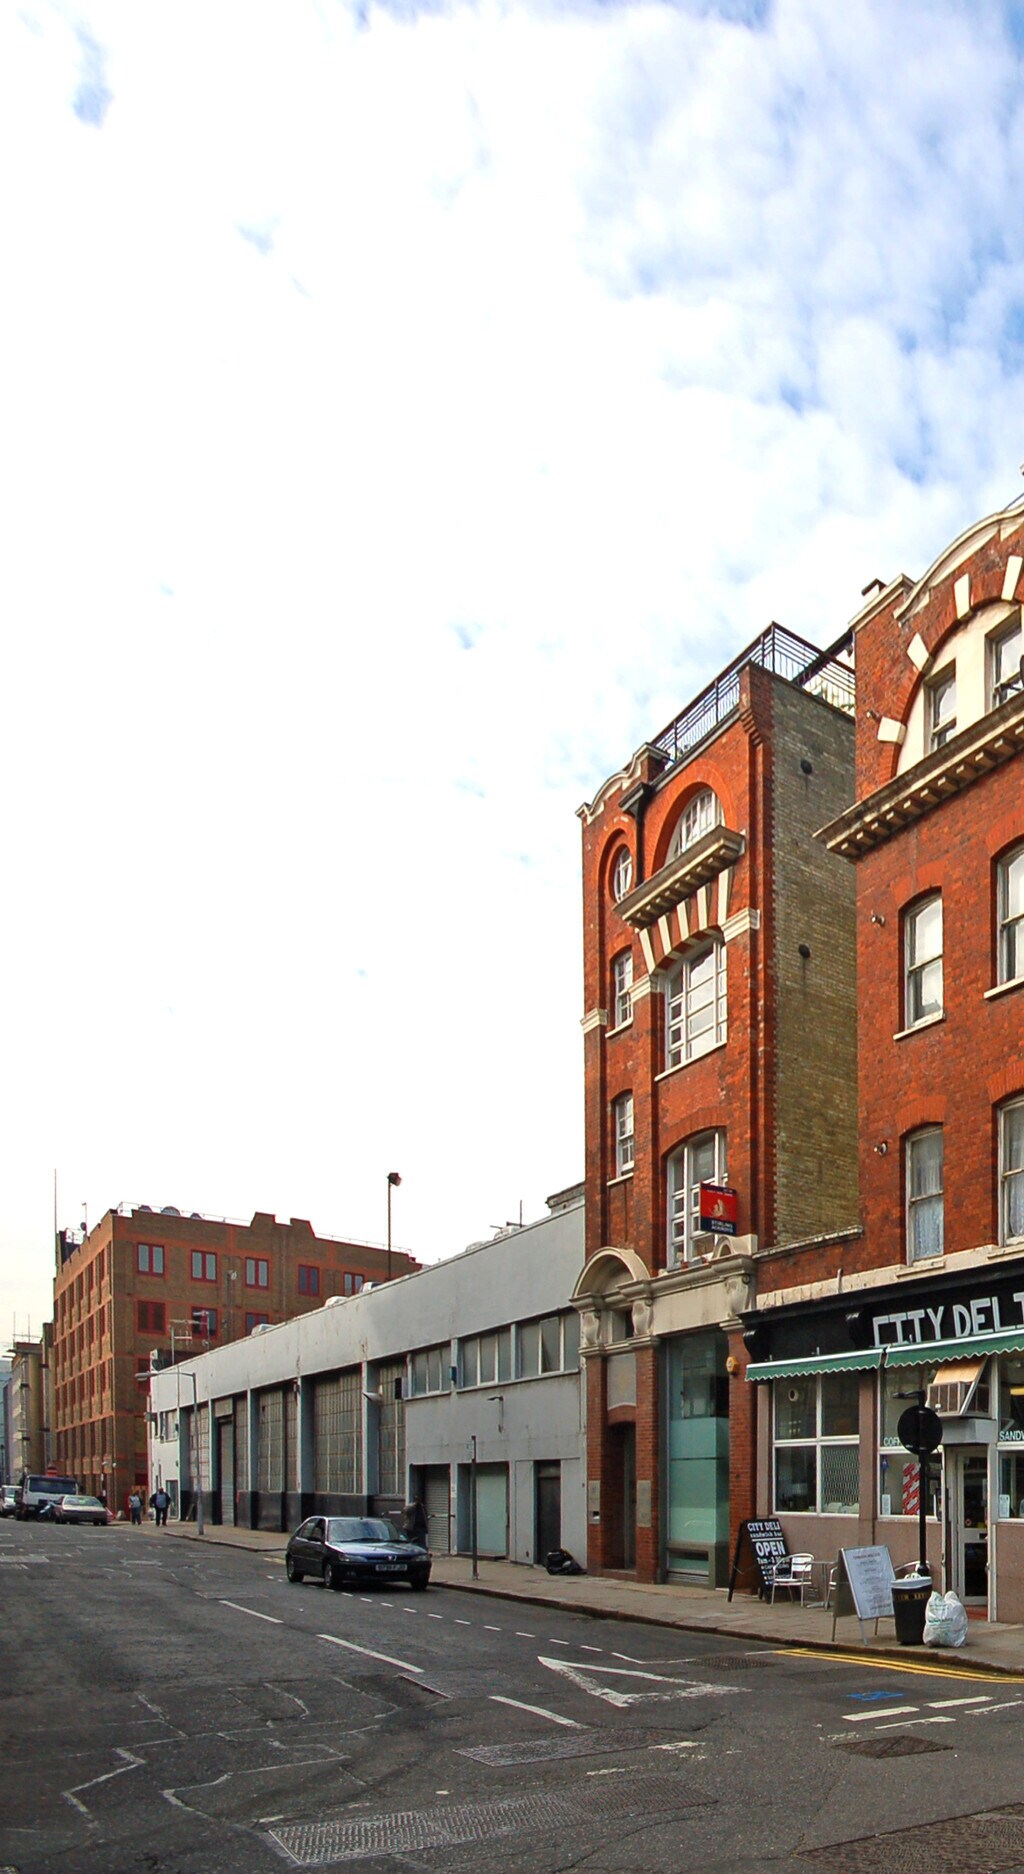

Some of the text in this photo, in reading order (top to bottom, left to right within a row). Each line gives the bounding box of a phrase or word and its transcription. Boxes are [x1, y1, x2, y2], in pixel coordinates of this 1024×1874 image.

[872, 1305, 944, 1348] CITY
[747, 1521, 781, 1531] CITY DELI
[755, 1541, 786, 1557] OPEN
